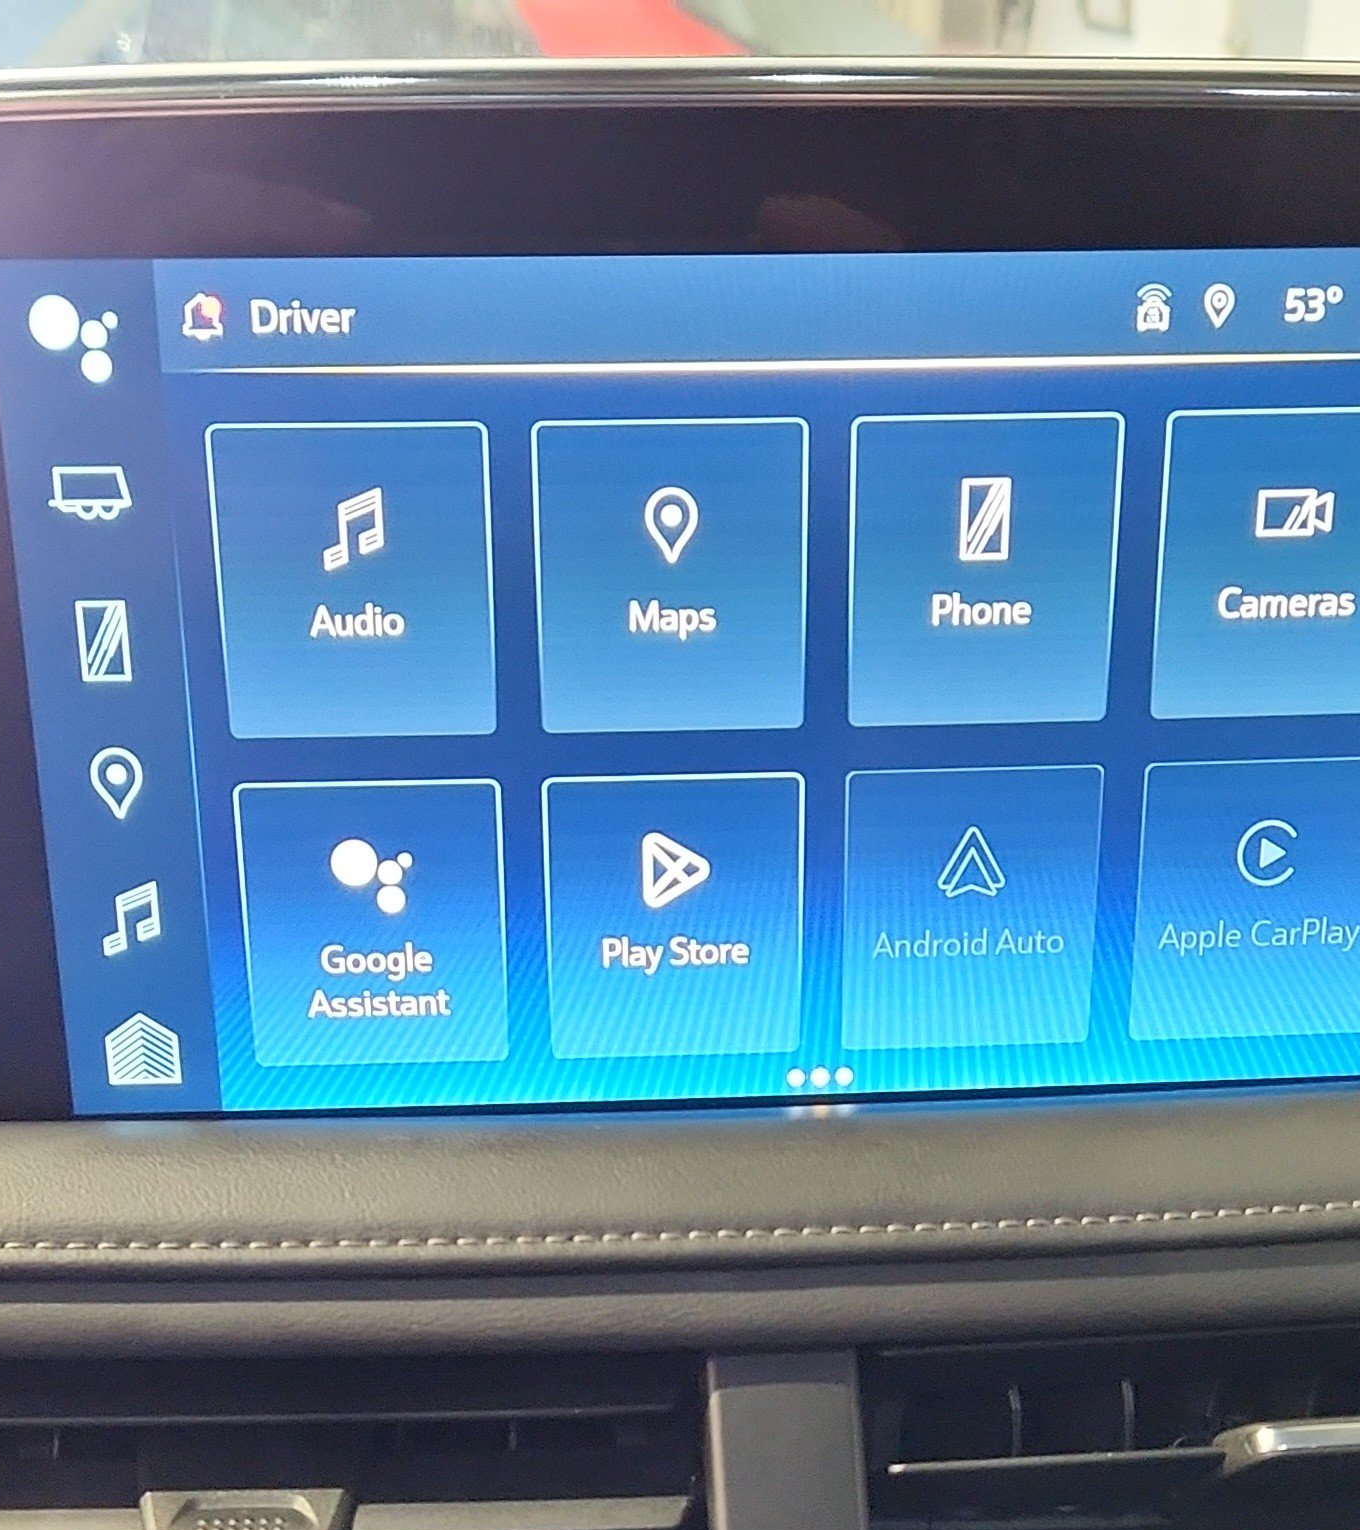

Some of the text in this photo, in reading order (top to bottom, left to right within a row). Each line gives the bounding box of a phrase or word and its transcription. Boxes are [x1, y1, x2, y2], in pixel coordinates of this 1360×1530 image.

[250, 299, 356, 336] Driver
[309, 603, 406, 638] Audio
[628, 600, 718, 640] Maps
[931, 592, 1033, 627] Phone
[1216, 587, 1357, 620] Cameras
[872, 926, 1066, 960] Android Auto
[1158, 916, 1360, 956] Apple CarPlay
[319, 941, 434, 982] Google
[601, 935, 750, 976] Play Store
[307, 987, 452, 1021] Assistant
